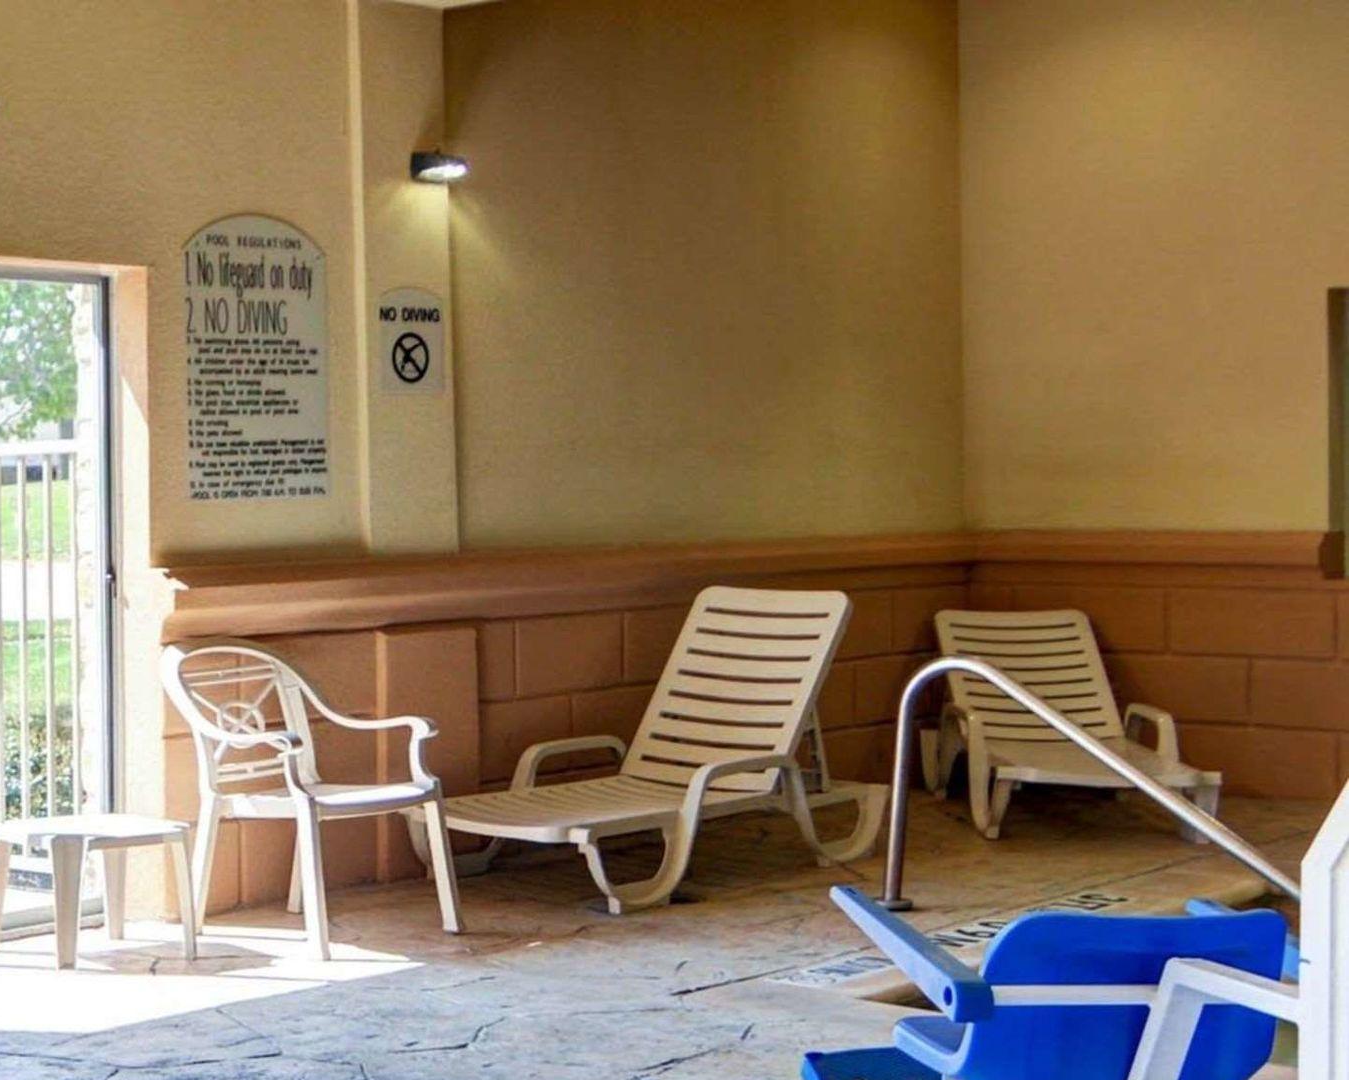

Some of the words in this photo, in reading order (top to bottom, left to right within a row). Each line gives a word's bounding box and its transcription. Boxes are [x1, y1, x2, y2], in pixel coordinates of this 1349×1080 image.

[206, 234, 229, 247] POOL
[237, 235, 302, 250] REGULATIONS
[196, 251, 214, 287] No
[219, 252, 265, 297] lifeguard
[270, 264, 284, 289] on
[289, 256, 313, 300] duty
[204, 297, 229, 334] NO
[237, 299, 288, 336] DIVING
[379, 307, 396, 322] NO
[402, 308, 440, 323] DIVING
